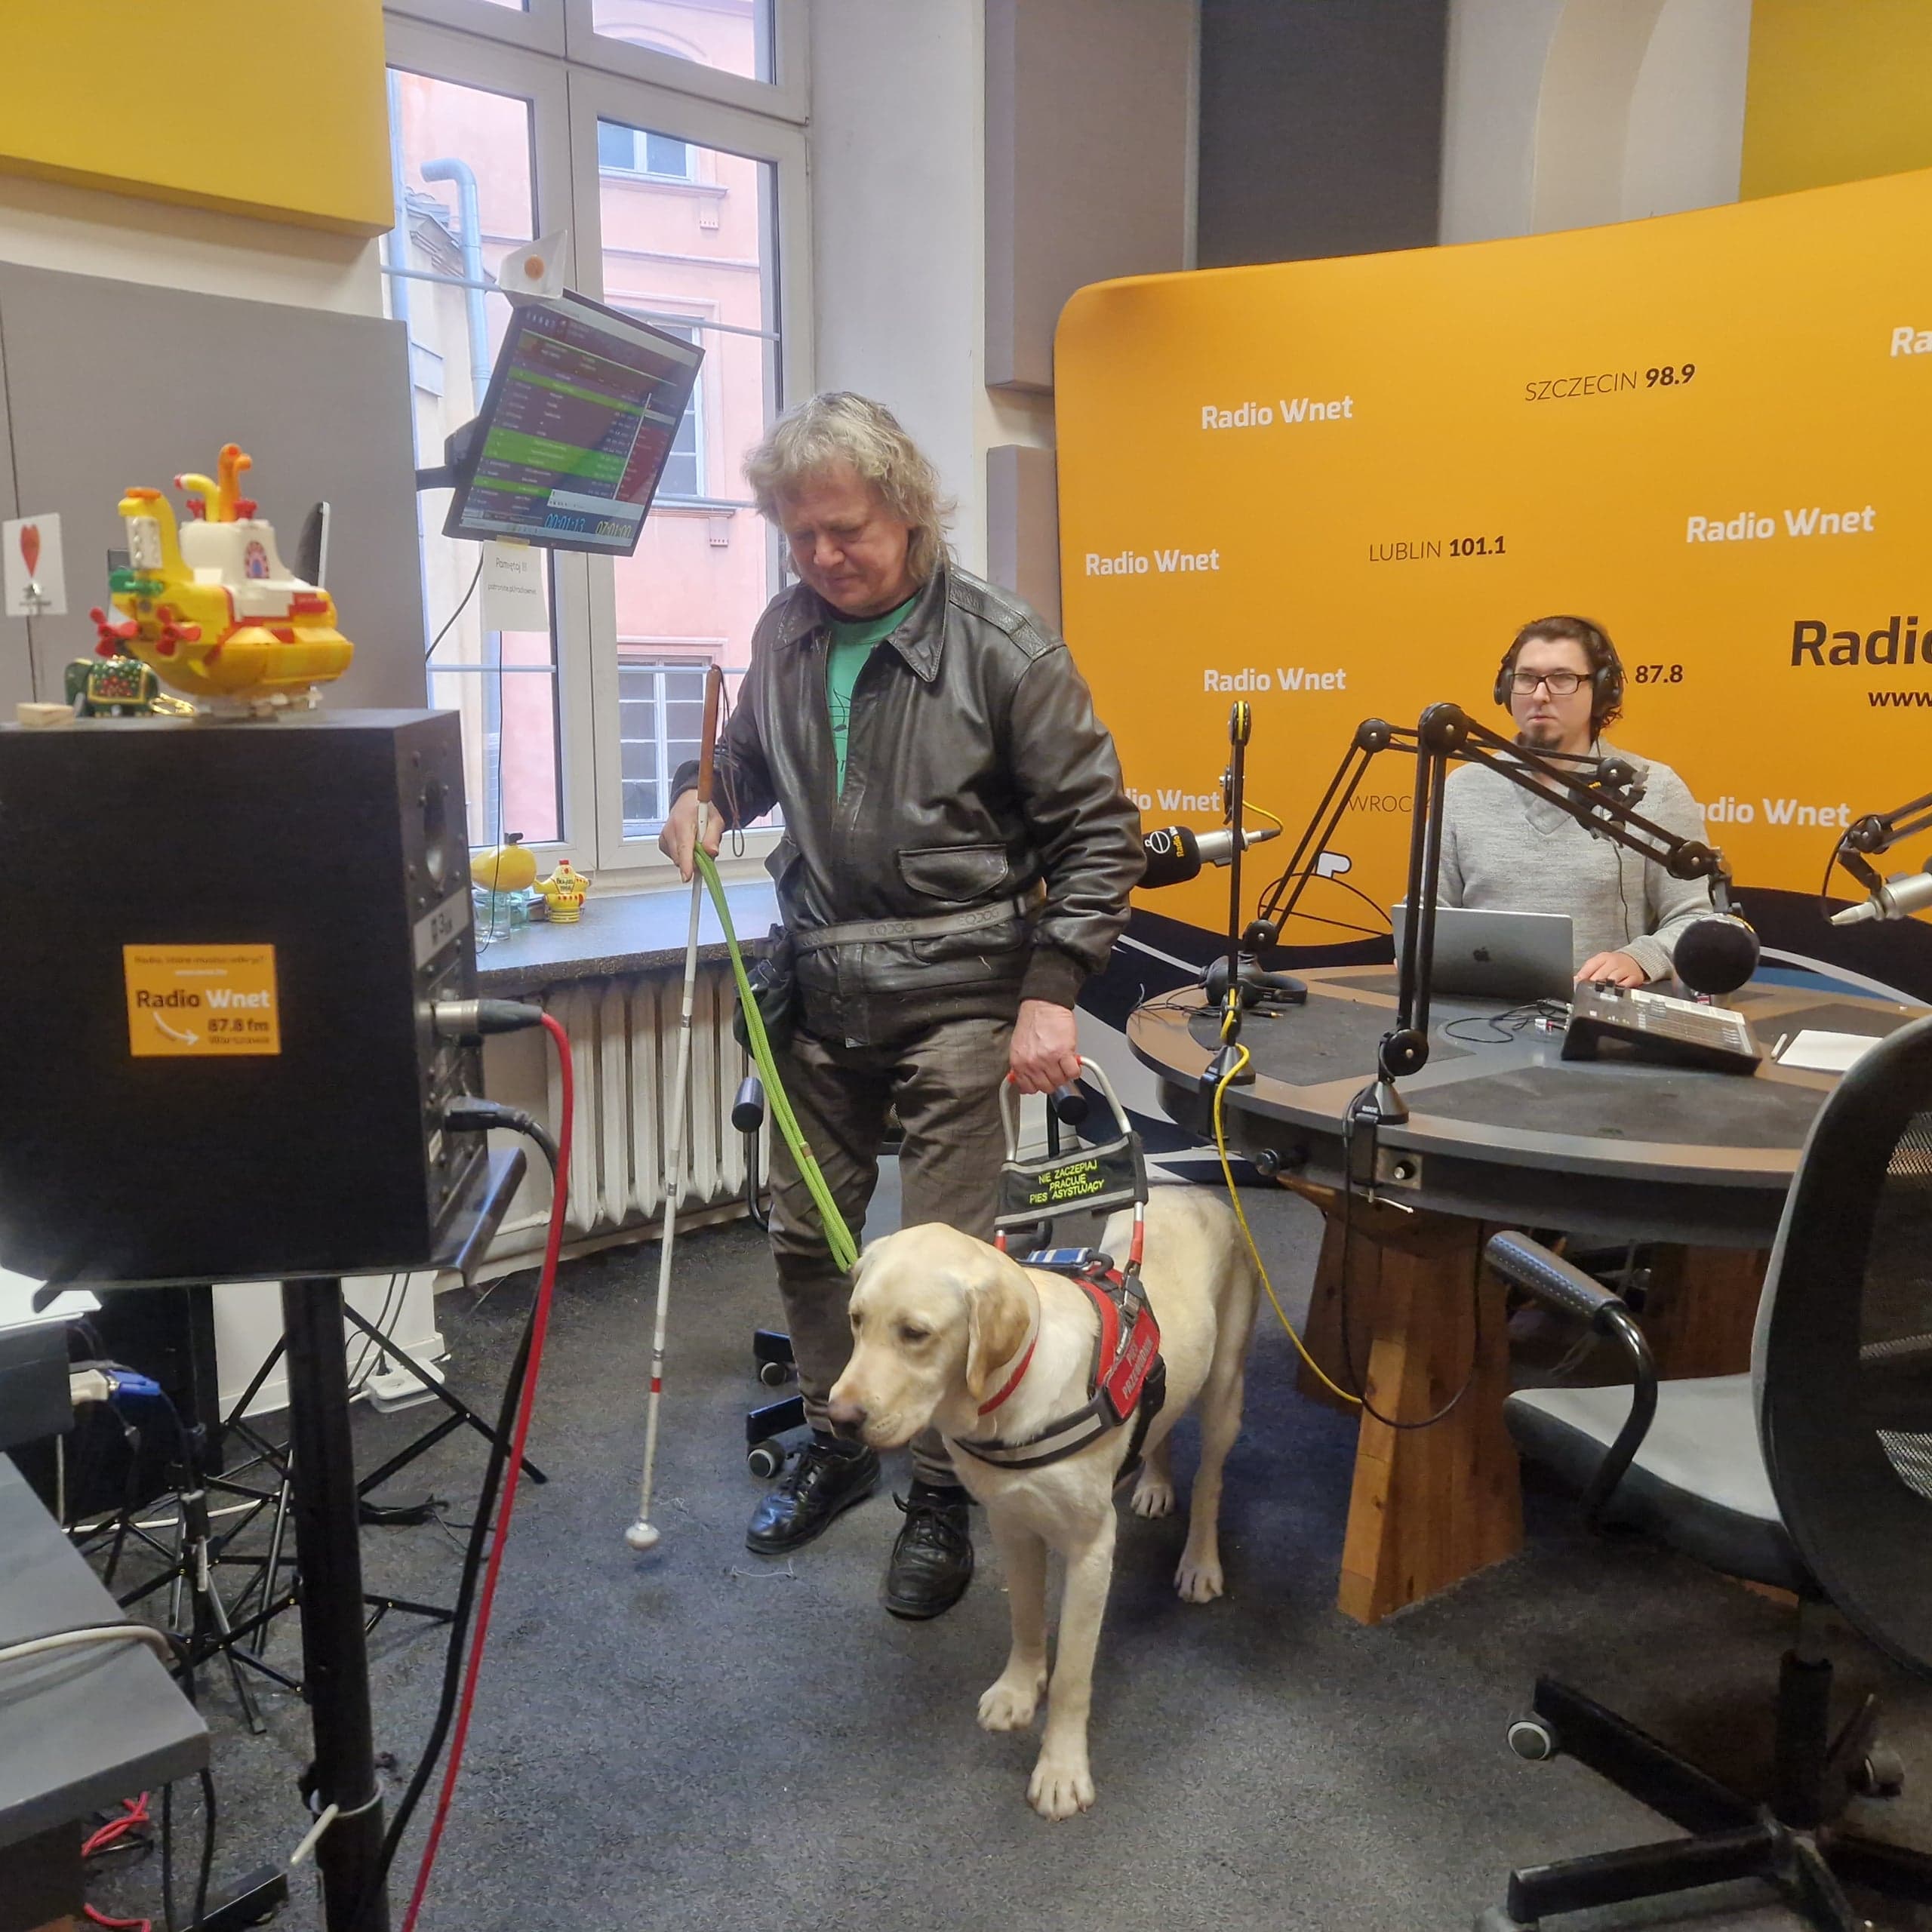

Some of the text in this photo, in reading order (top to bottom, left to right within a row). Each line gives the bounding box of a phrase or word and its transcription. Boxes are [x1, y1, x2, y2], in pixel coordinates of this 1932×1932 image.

[1524, 364, 1695, 401] SZCZECIN 98.9
[1201, 395, 1353, 429] Radio Wnet
[1686, 505, 1876, 543] Radio Wnet
[1369, 536, 1506, 561] LUBLIN 101.1
[1085, 549, 1220, 576] Radio Wnet
[1204, 667, 1346, 692] Radio Wnet
[1635, 664, 1684, 684] 87.8
[1156, 789, 1220, 812] Wnet
[1762, 798, 1851, 827] Wnet
[137, 989, 271, 1008] Radio Wnet
[208, 1019, 269, 1032] 87.8 fm
[1038, 1159, 1098, 1185] NIE ZACZEPIAJ
[1029, 1192, 1048, 1204] PIES
